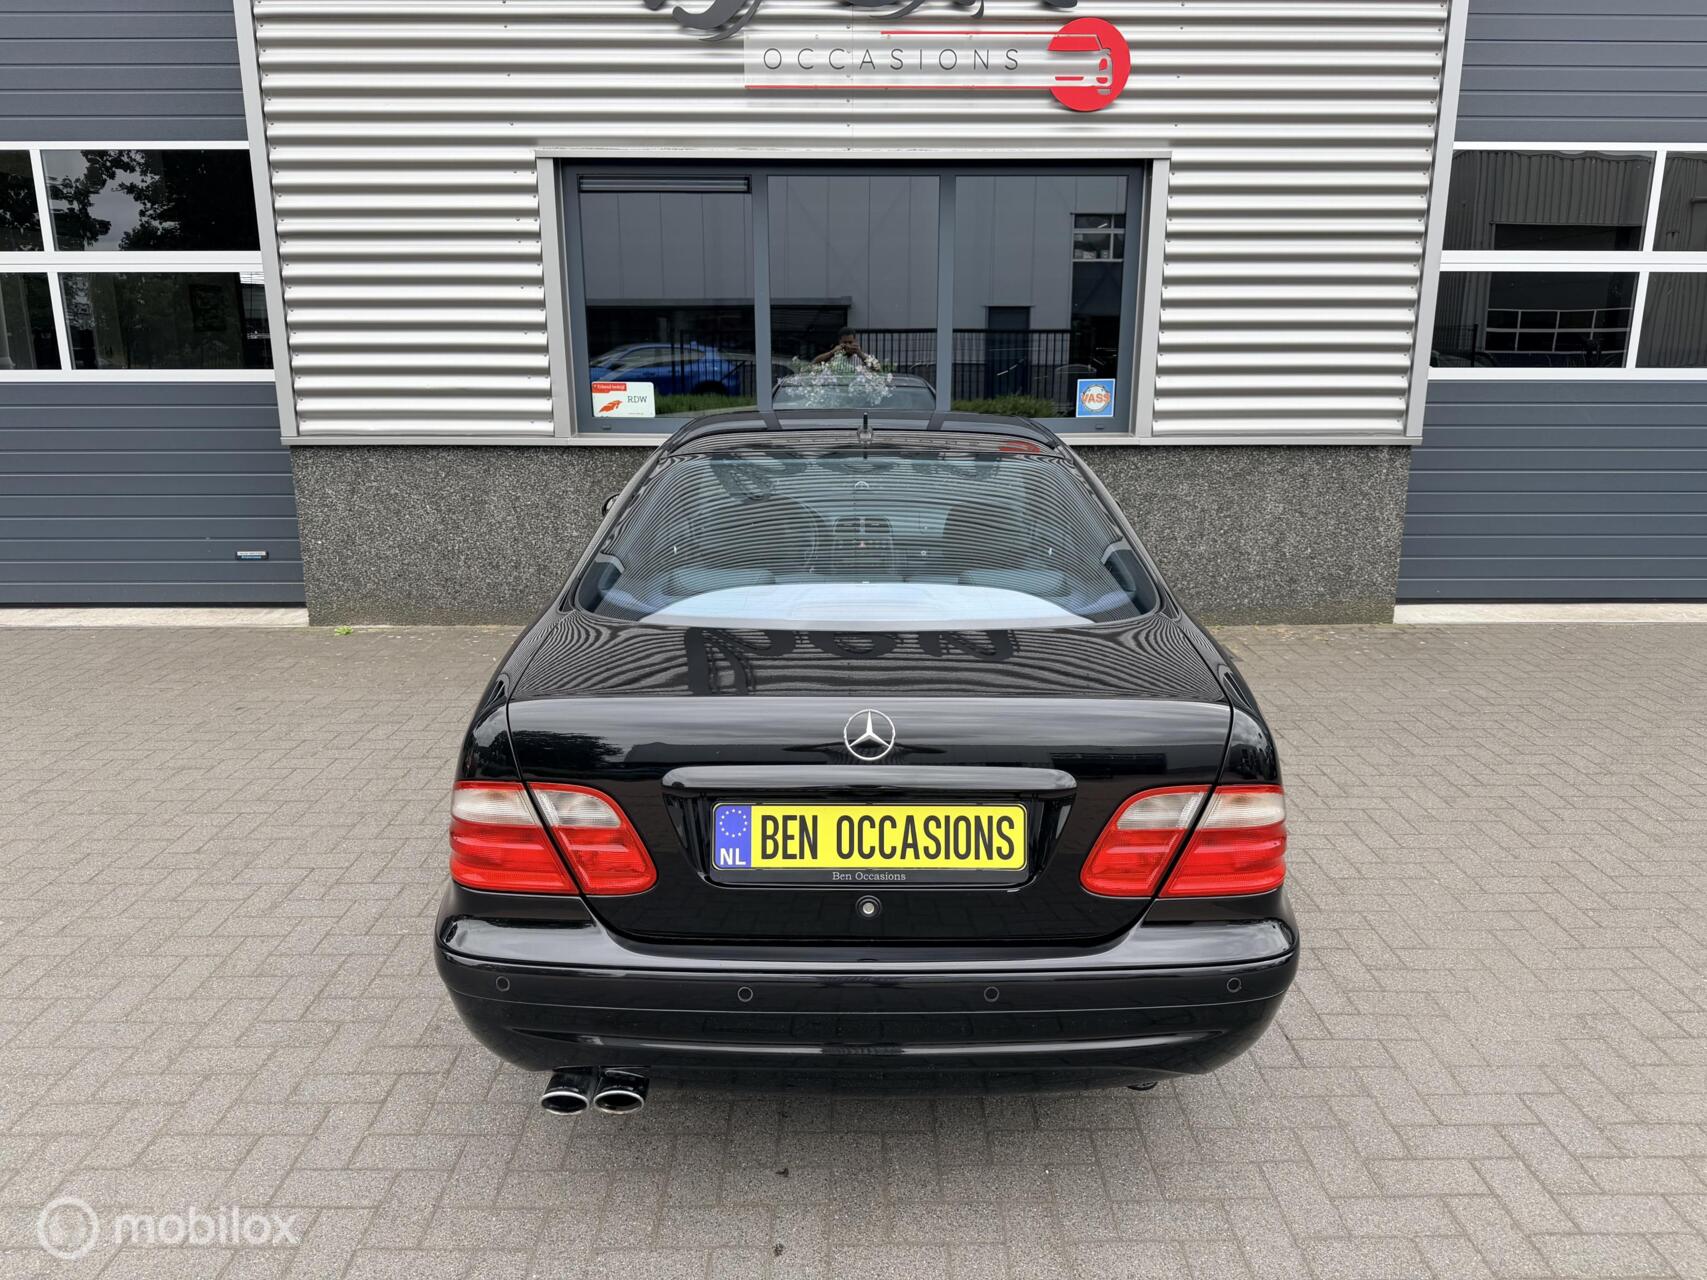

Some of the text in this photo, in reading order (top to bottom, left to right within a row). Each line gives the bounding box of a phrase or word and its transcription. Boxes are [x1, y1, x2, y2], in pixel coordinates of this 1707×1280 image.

[763, 47, 1019, 71] OCCASIONS
[627, 395, 648, 403] RDW
[1081, 392, 1111, 404] VASS
[761, 814, 1015, 861] BEN OCCASIONS
[719, 848, 746, 866] NL
[832, 871, 906, 881] Ben Occasions
